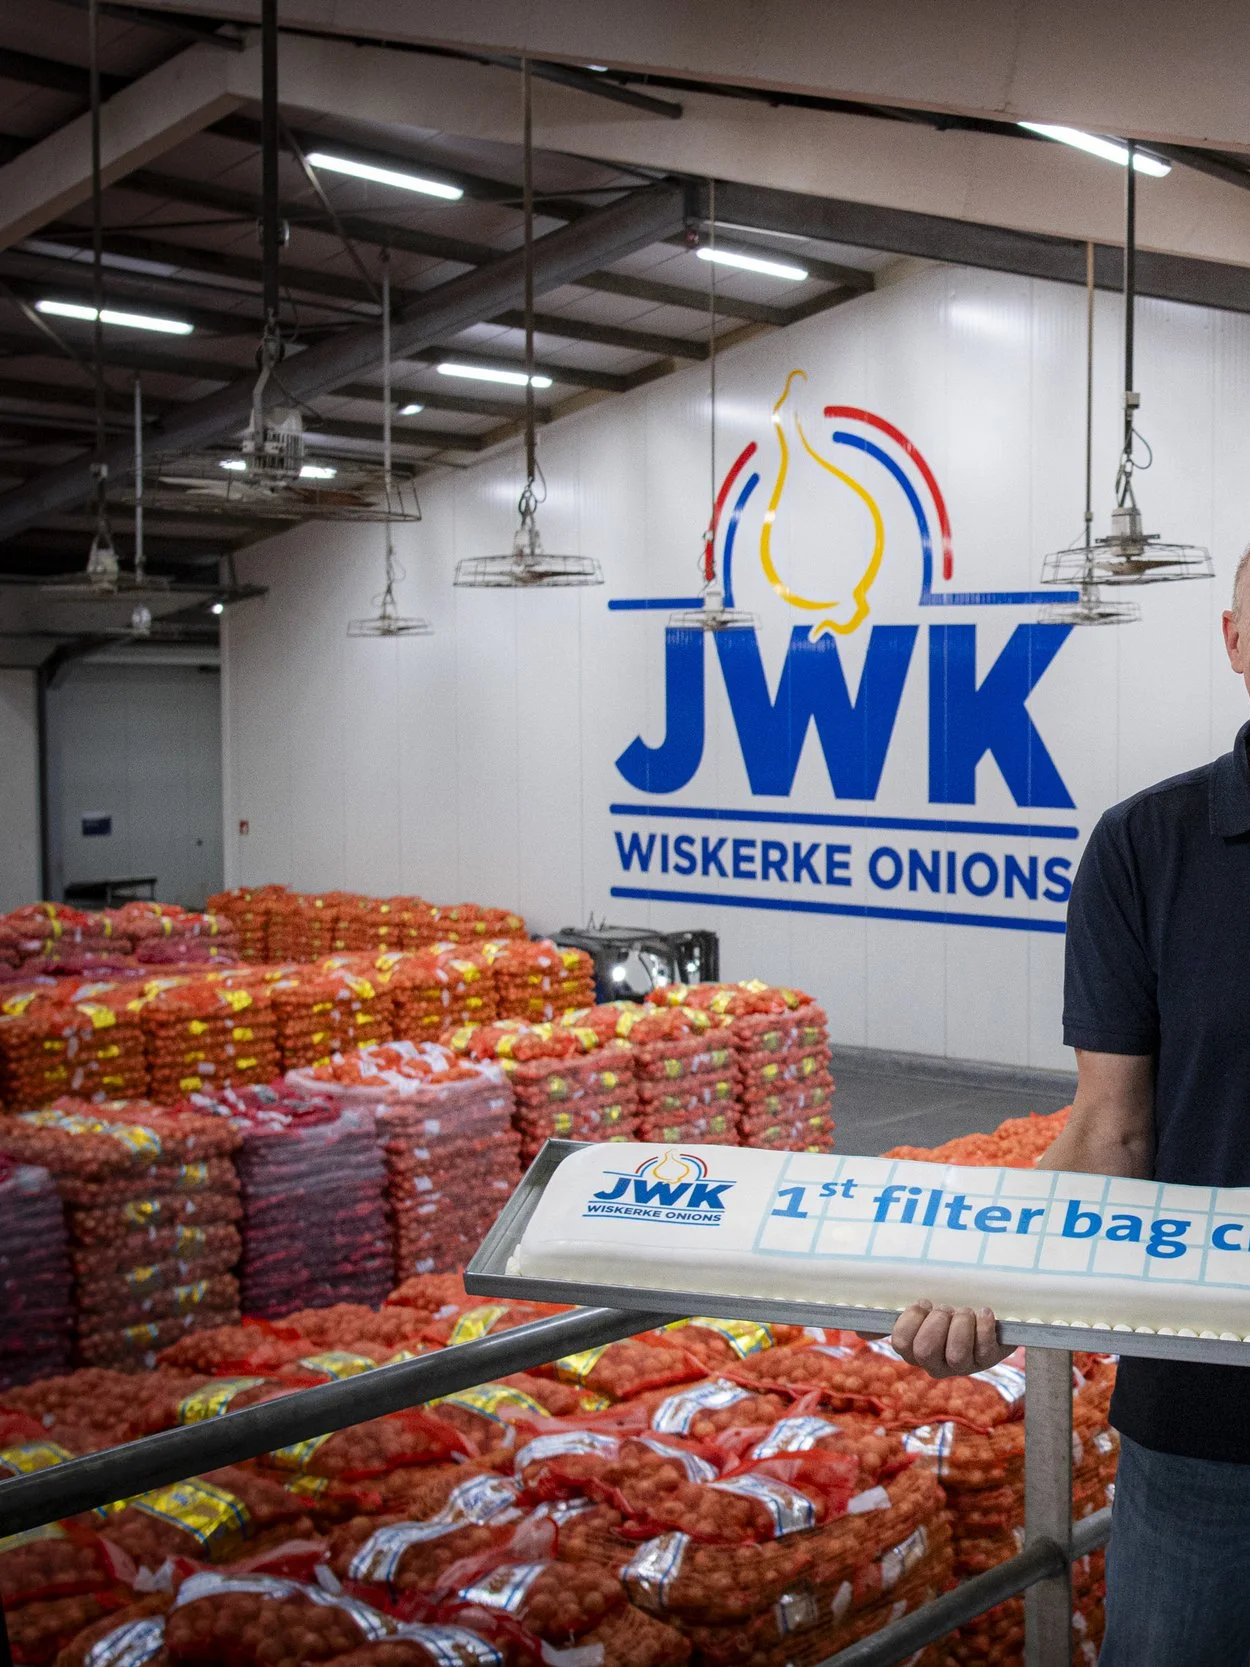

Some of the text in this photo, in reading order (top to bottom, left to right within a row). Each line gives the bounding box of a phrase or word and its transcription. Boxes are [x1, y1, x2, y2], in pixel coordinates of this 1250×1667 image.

[614, 622, 1077, 810] JWK
[614, 831, 1073, 903] WISKERKE ONIONS
[587, 1204, 722, 1222] WISKERKE ONIONS
[593, 1177, 735, 1209] JWK
[770, 1176, 859, 1219] 1st
[871, 1184, 1045, 1235] filter
[1061, 1199, 1192, 1259] bag
